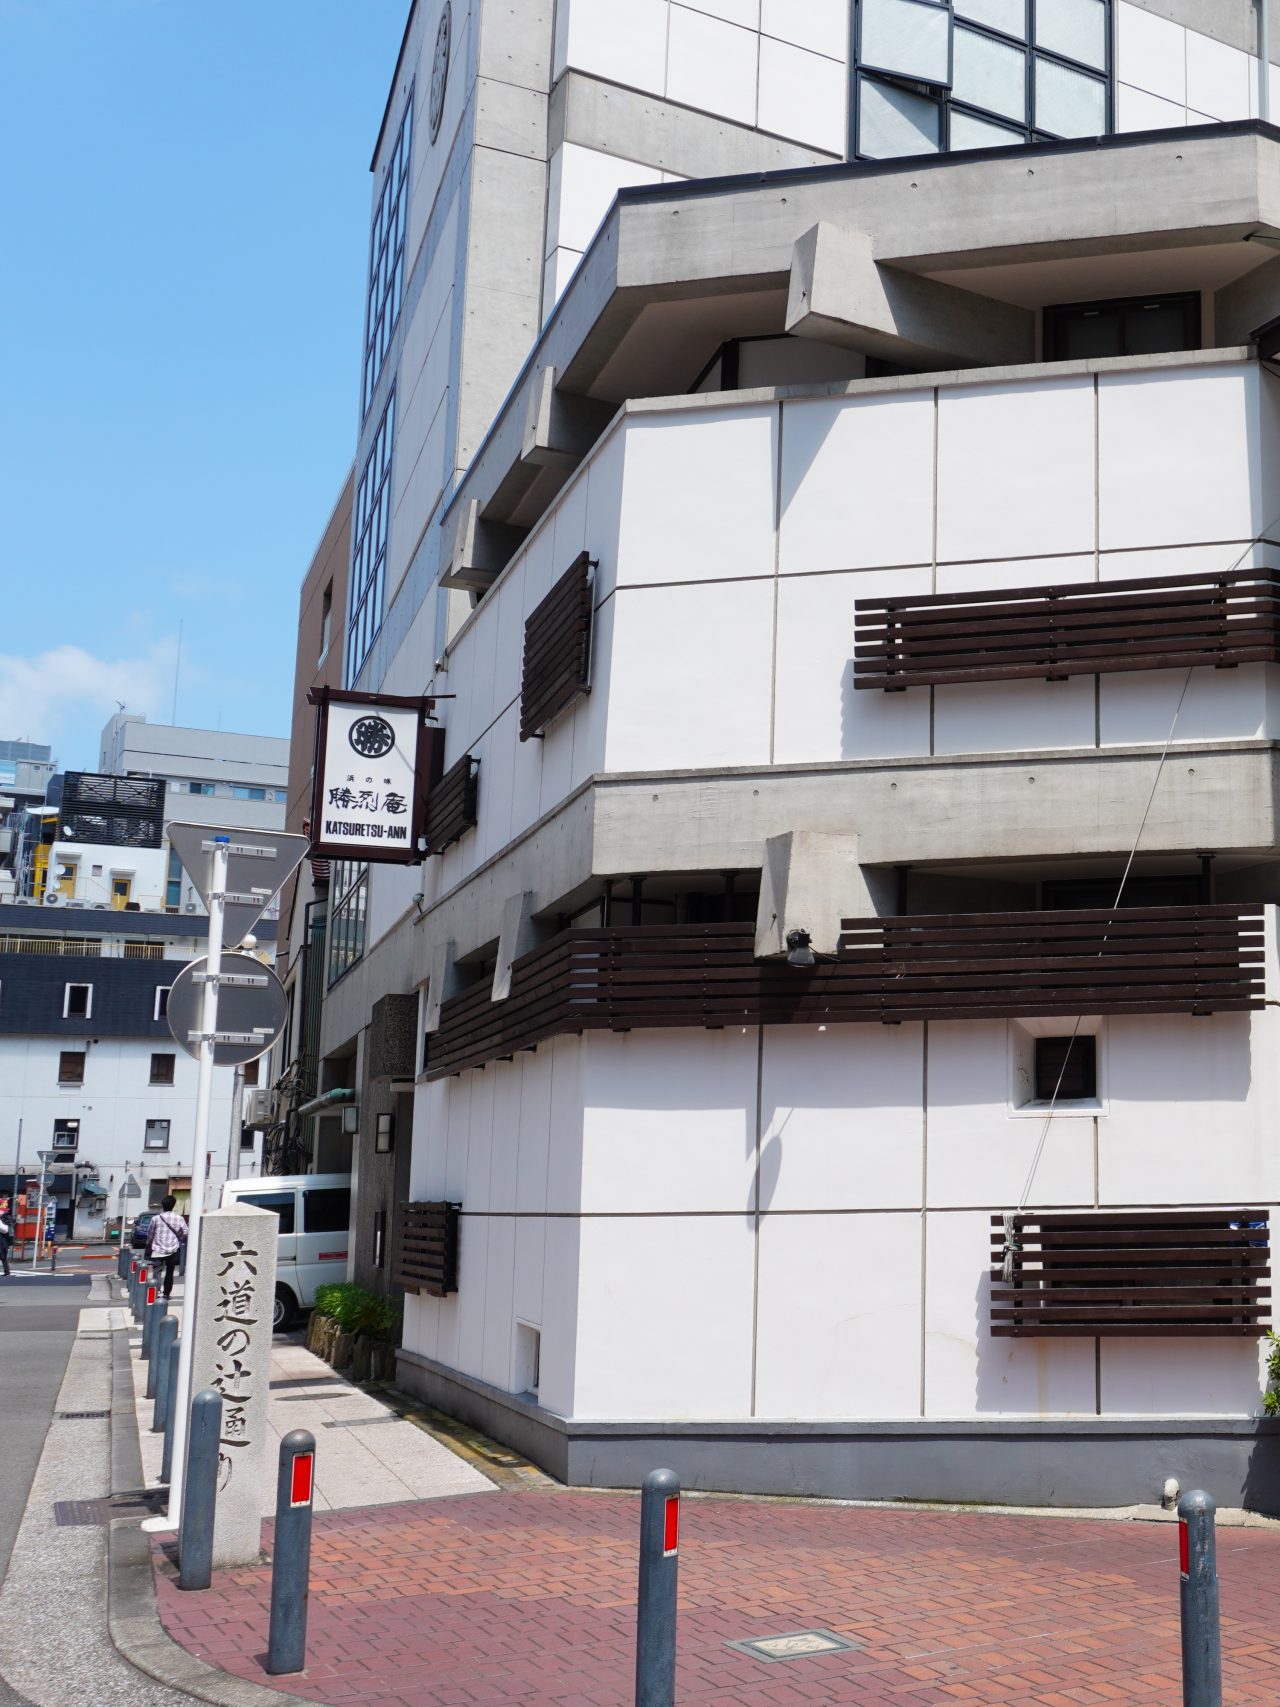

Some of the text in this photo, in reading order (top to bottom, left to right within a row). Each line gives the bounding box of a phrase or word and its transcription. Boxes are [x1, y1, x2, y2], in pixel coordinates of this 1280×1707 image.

[346, 774, 392, 785] 浜の味
[328, 787, 408, 815] 勝烈庵
[325, 820, 407, 840] KATSURETSU-ANN
[210, 1240, 258, 1493] 六道の辻通り
